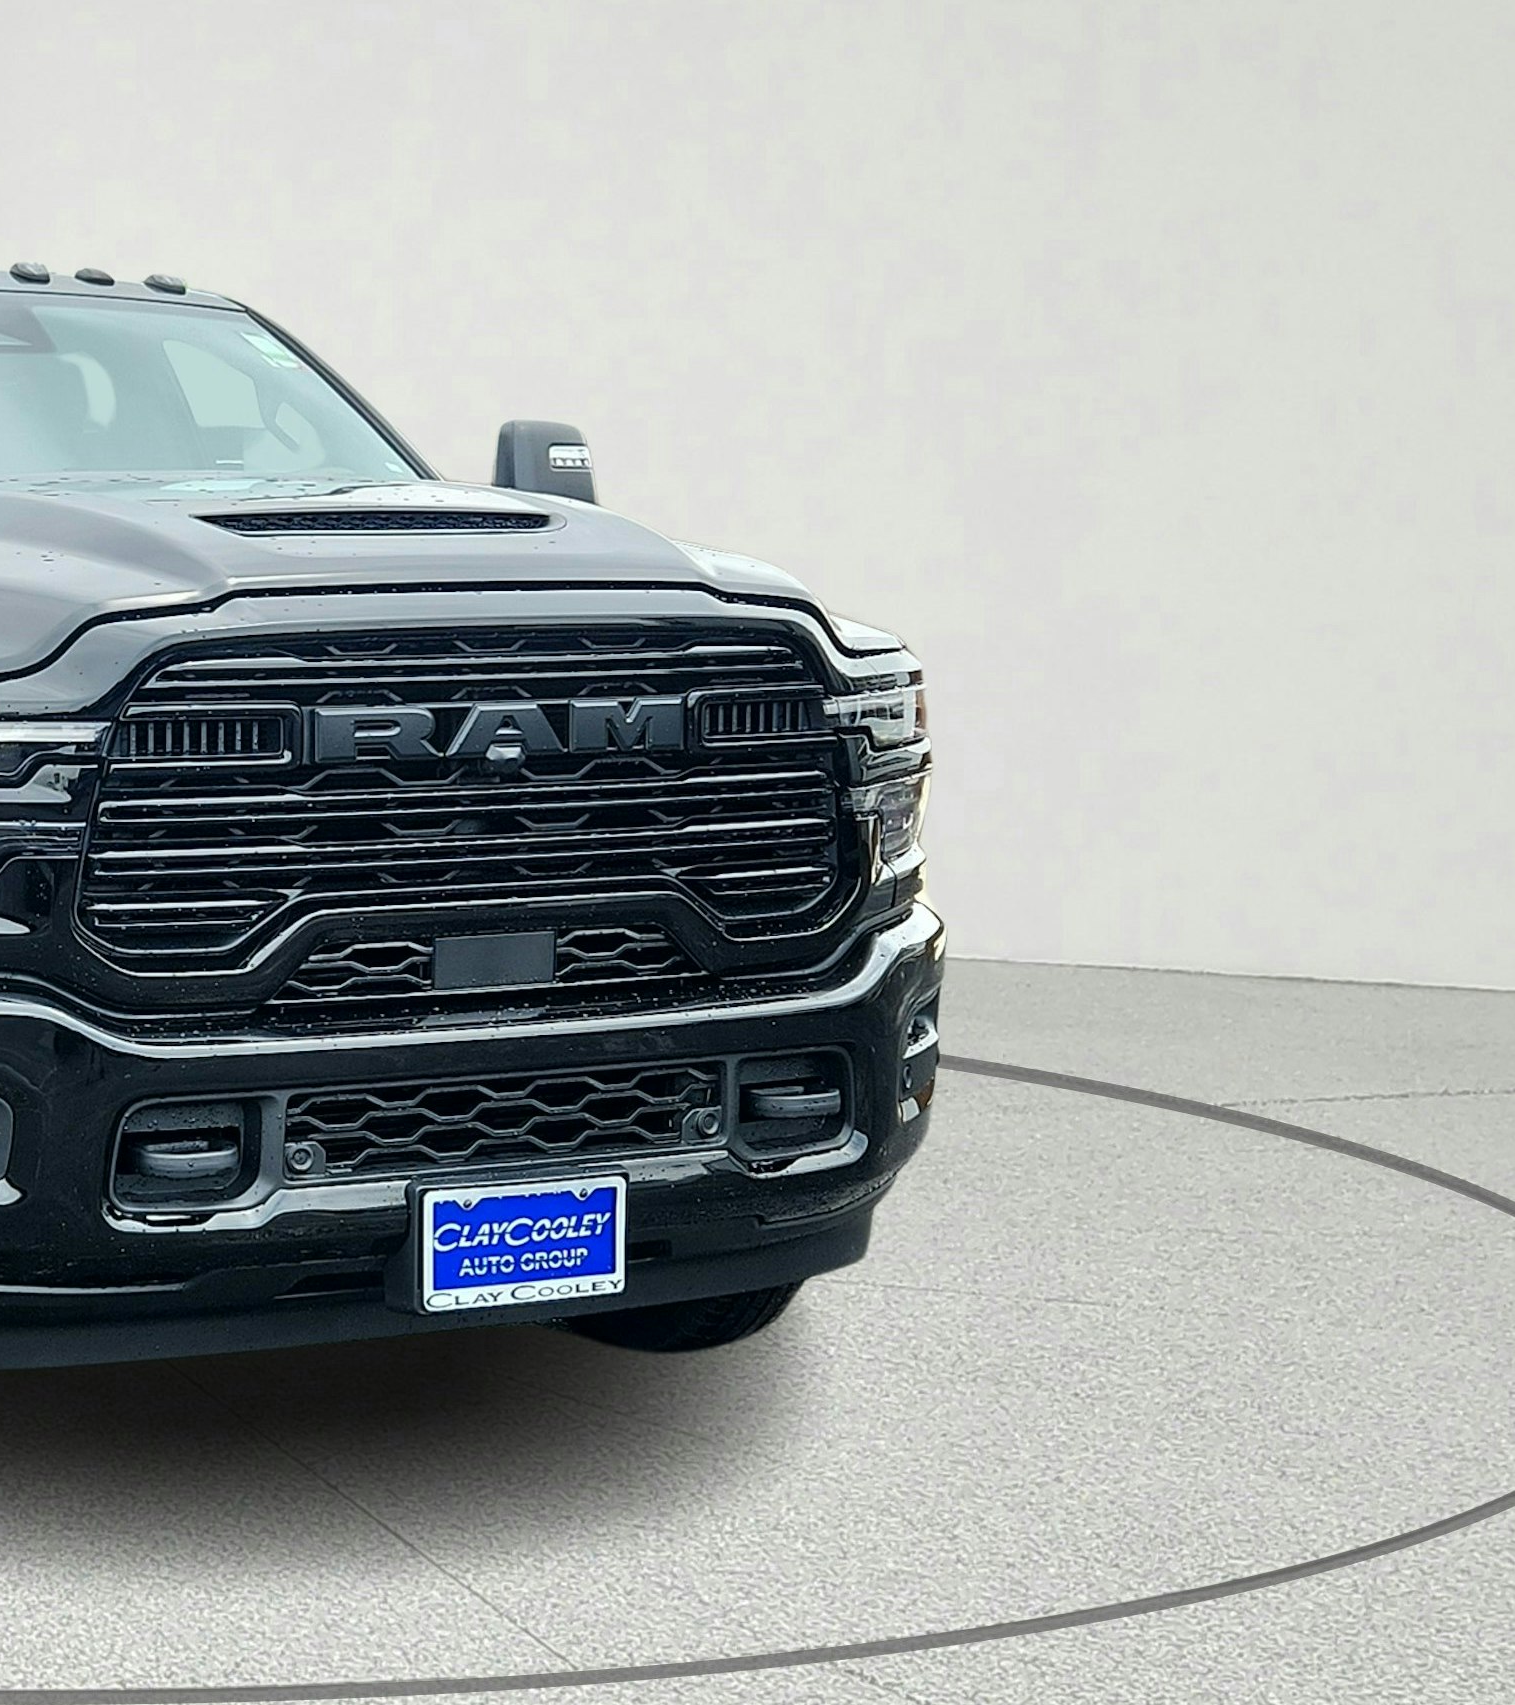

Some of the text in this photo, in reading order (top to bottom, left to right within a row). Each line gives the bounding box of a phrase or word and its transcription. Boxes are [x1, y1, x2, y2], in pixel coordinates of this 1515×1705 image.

[314, 697, 683, 763] RAM
[459, 1248, 588, 1278] AUTO GROUP
[426, 1279, 623, 1309] CLAY COOLEY
